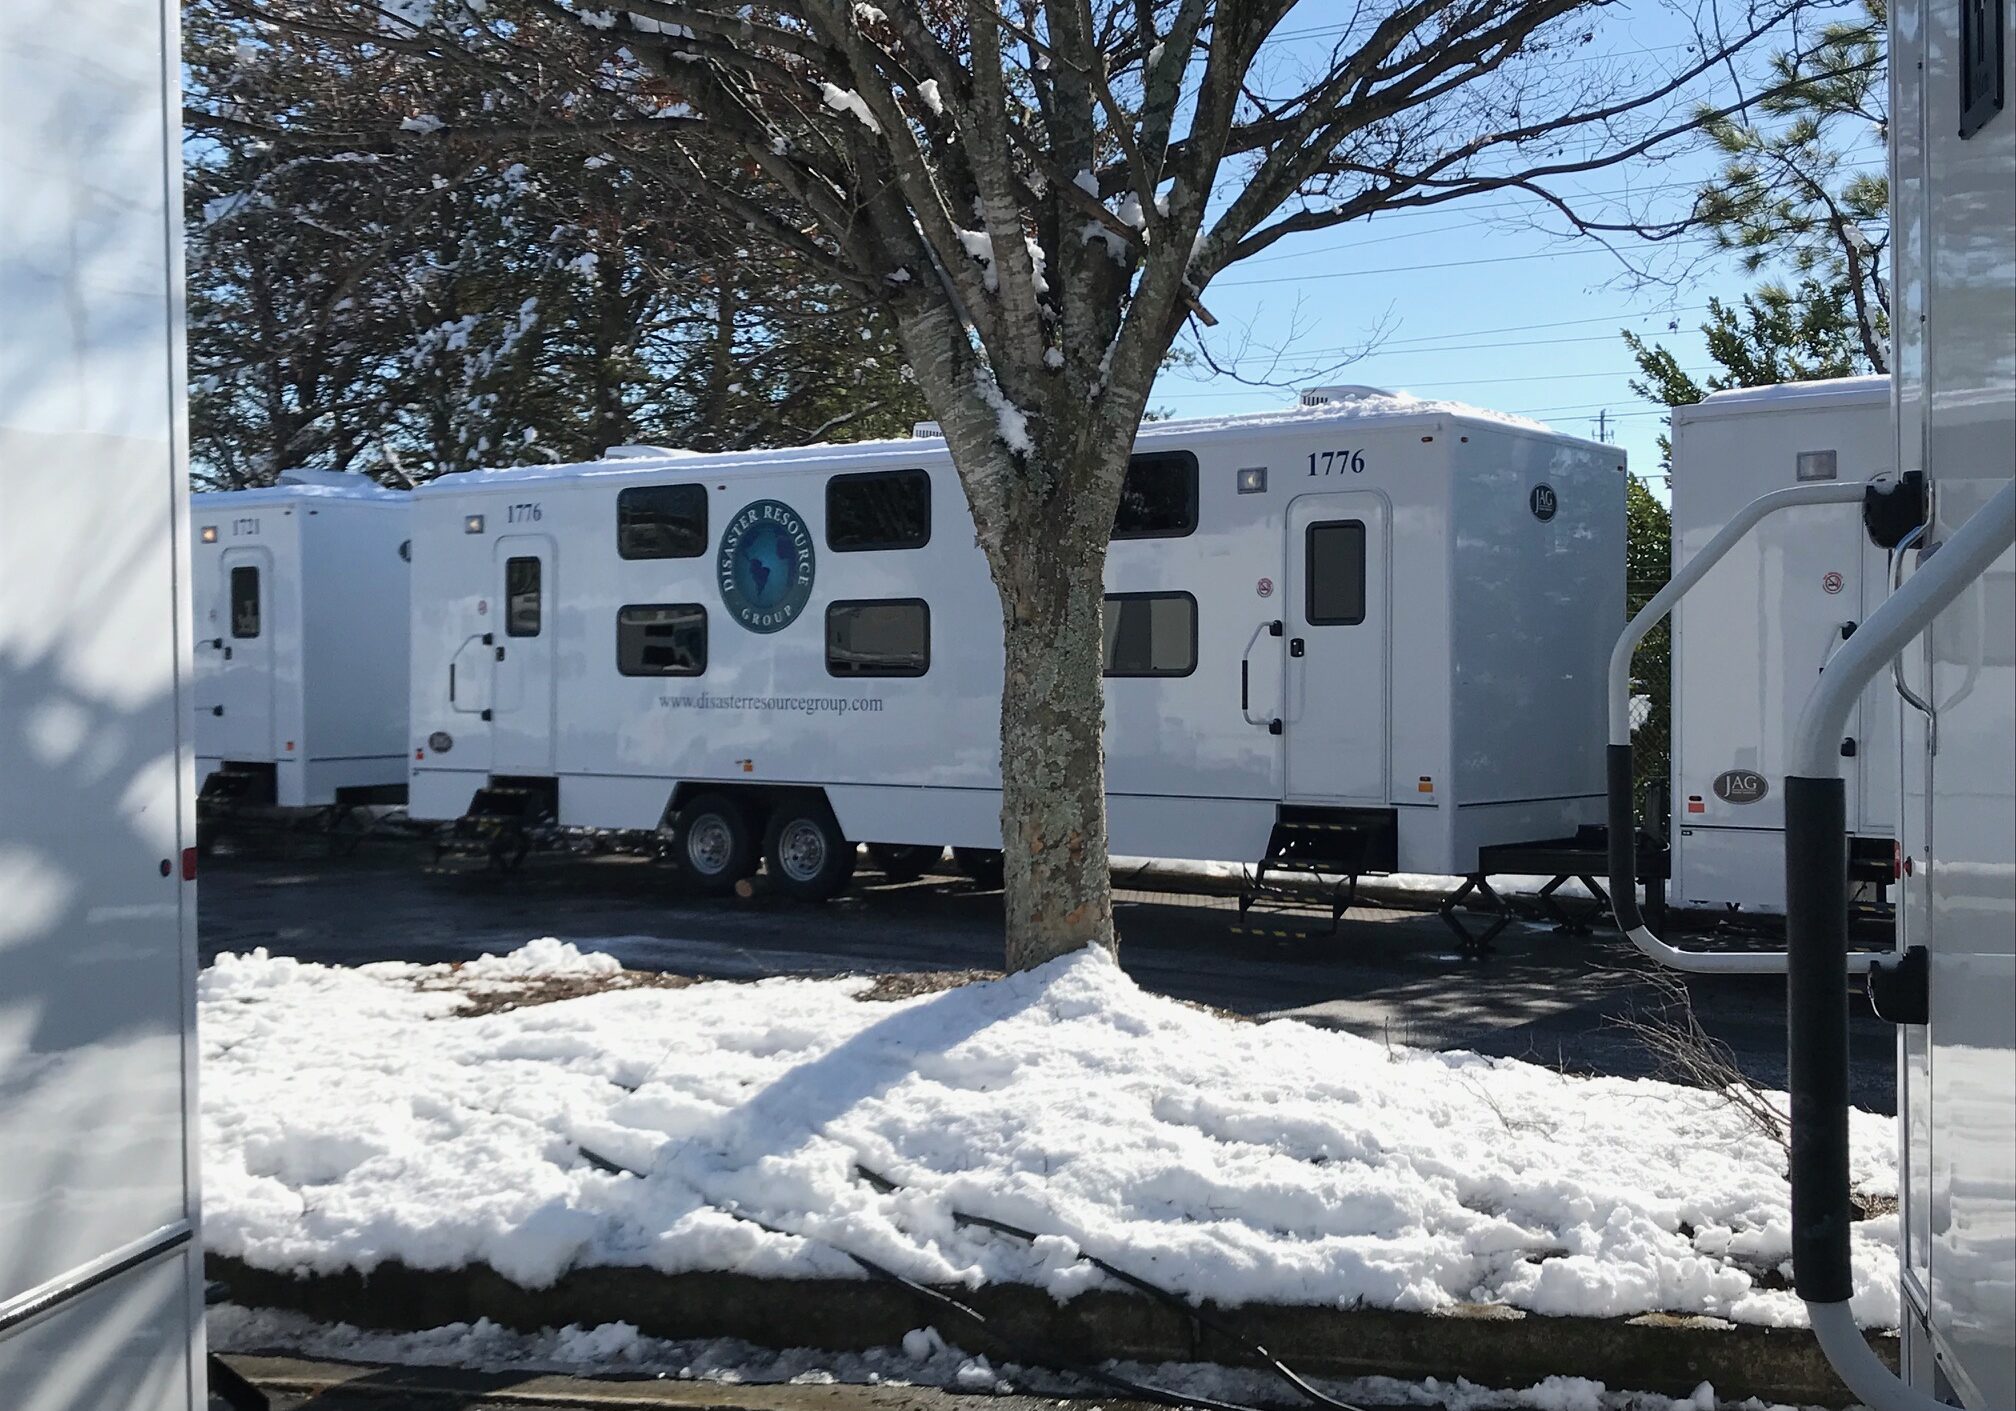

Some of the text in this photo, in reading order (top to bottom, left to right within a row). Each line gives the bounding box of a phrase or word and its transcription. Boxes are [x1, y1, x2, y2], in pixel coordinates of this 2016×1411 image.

[1307, 448, 1366, 477] 1776
[508, 502, 543, 523] 1776
[722, 505, 811, 592] DISASTER RESOURCE
[741, 605, 792, 626] GROUP
[659, 692, 883, 716] www.disasterresourcegroup.com
[1724, 775, 1758, 797] JAG
